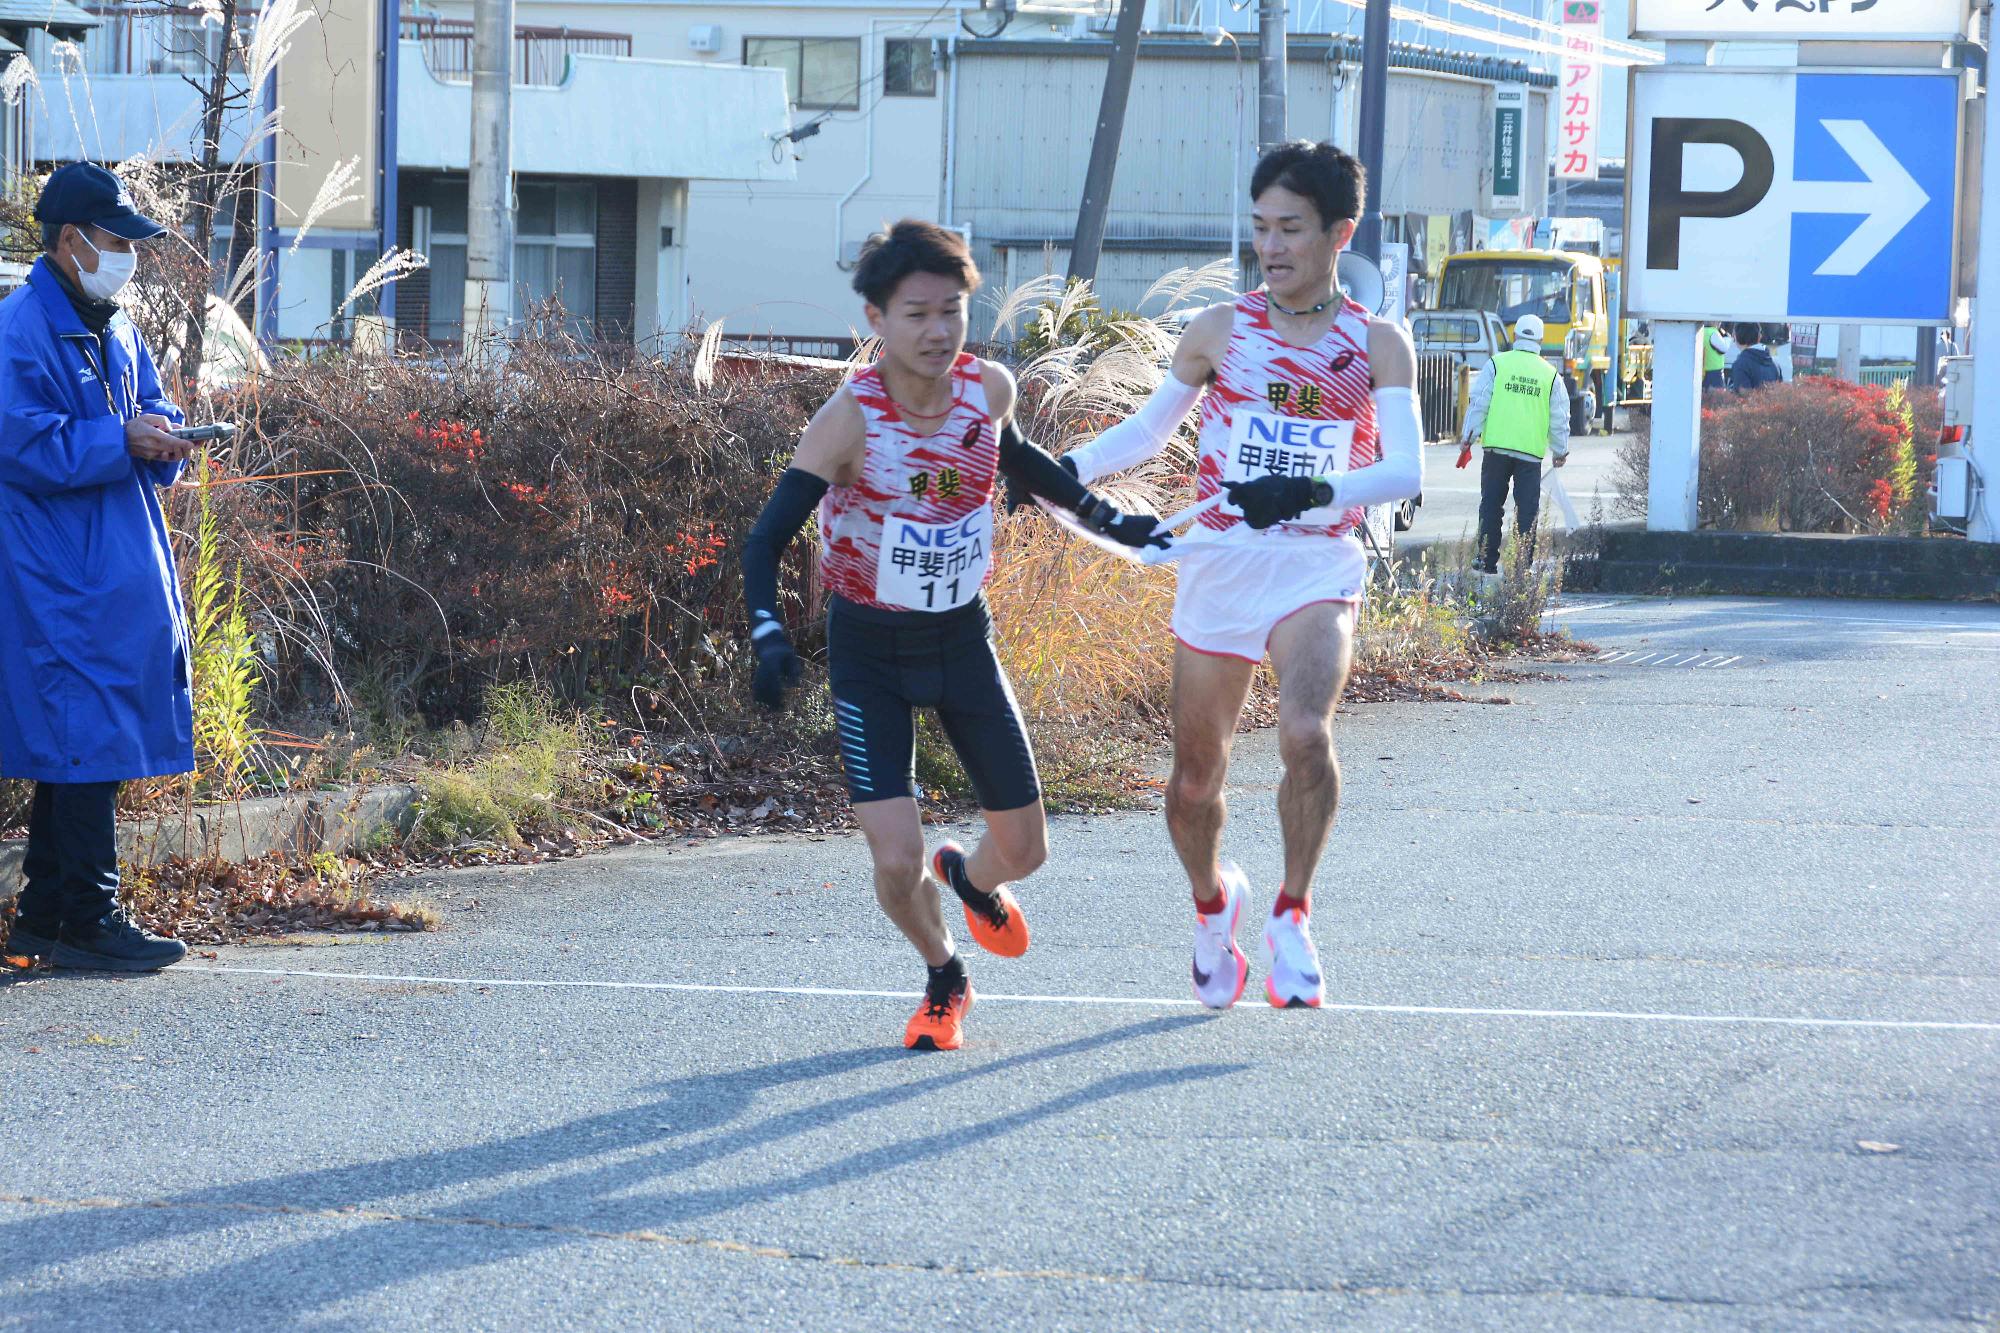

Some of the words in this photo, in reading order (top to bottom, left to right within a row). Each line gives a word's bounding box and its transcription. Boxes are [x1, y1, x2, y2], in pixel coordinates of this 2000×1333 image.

[1501, 112, 1514, 179] 三井住友海上
[1646, 117, 1774, 270] P
[1267, 381, 1321, 416] 甲斐
[1248, 416, 1339, 448] NEC
[908, 468, 961, 501] 甲斐
[901, 511, 982, 547] NEC
[920, 578, 961, 608] 11
